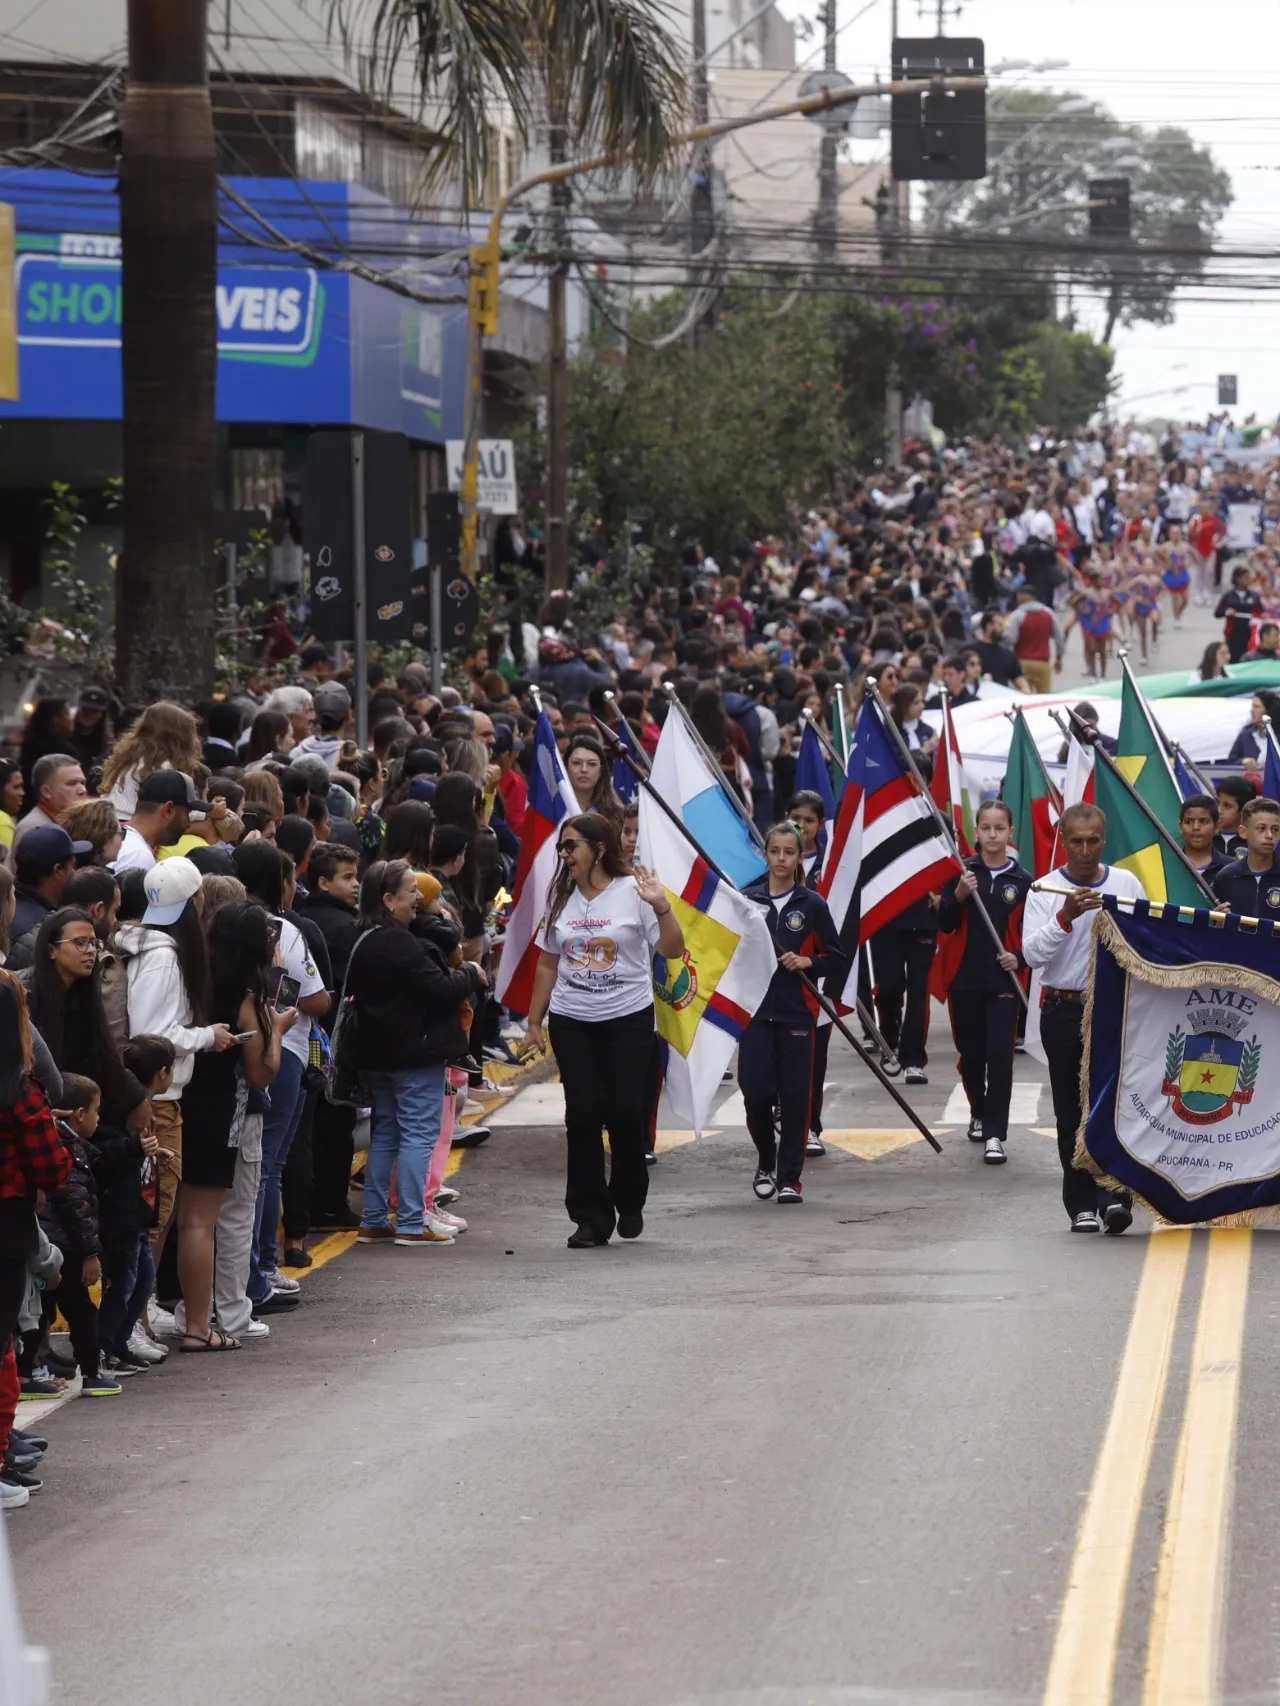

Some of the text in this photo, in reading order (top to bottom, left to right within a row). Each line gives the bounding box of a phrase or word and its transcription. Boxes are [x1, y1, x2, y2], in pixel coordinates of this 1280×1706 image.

[26, 281, 121, 324] SHO
[147, 887, 161, 903] NY
[566, 918, 612, 926] APUCARANA
[1185, 988, 1257, 1016] AME
[1129, 1093, 1165, 1134] AUTARQUIA
[1166, 1127, 1215, 1144] MUNICIPAL
[1218, 1133, 1233, 1144] DE
[1157, 1155, 1210, 1168] APUCARANA
[1218, 1161, 1233, 1172] PR
